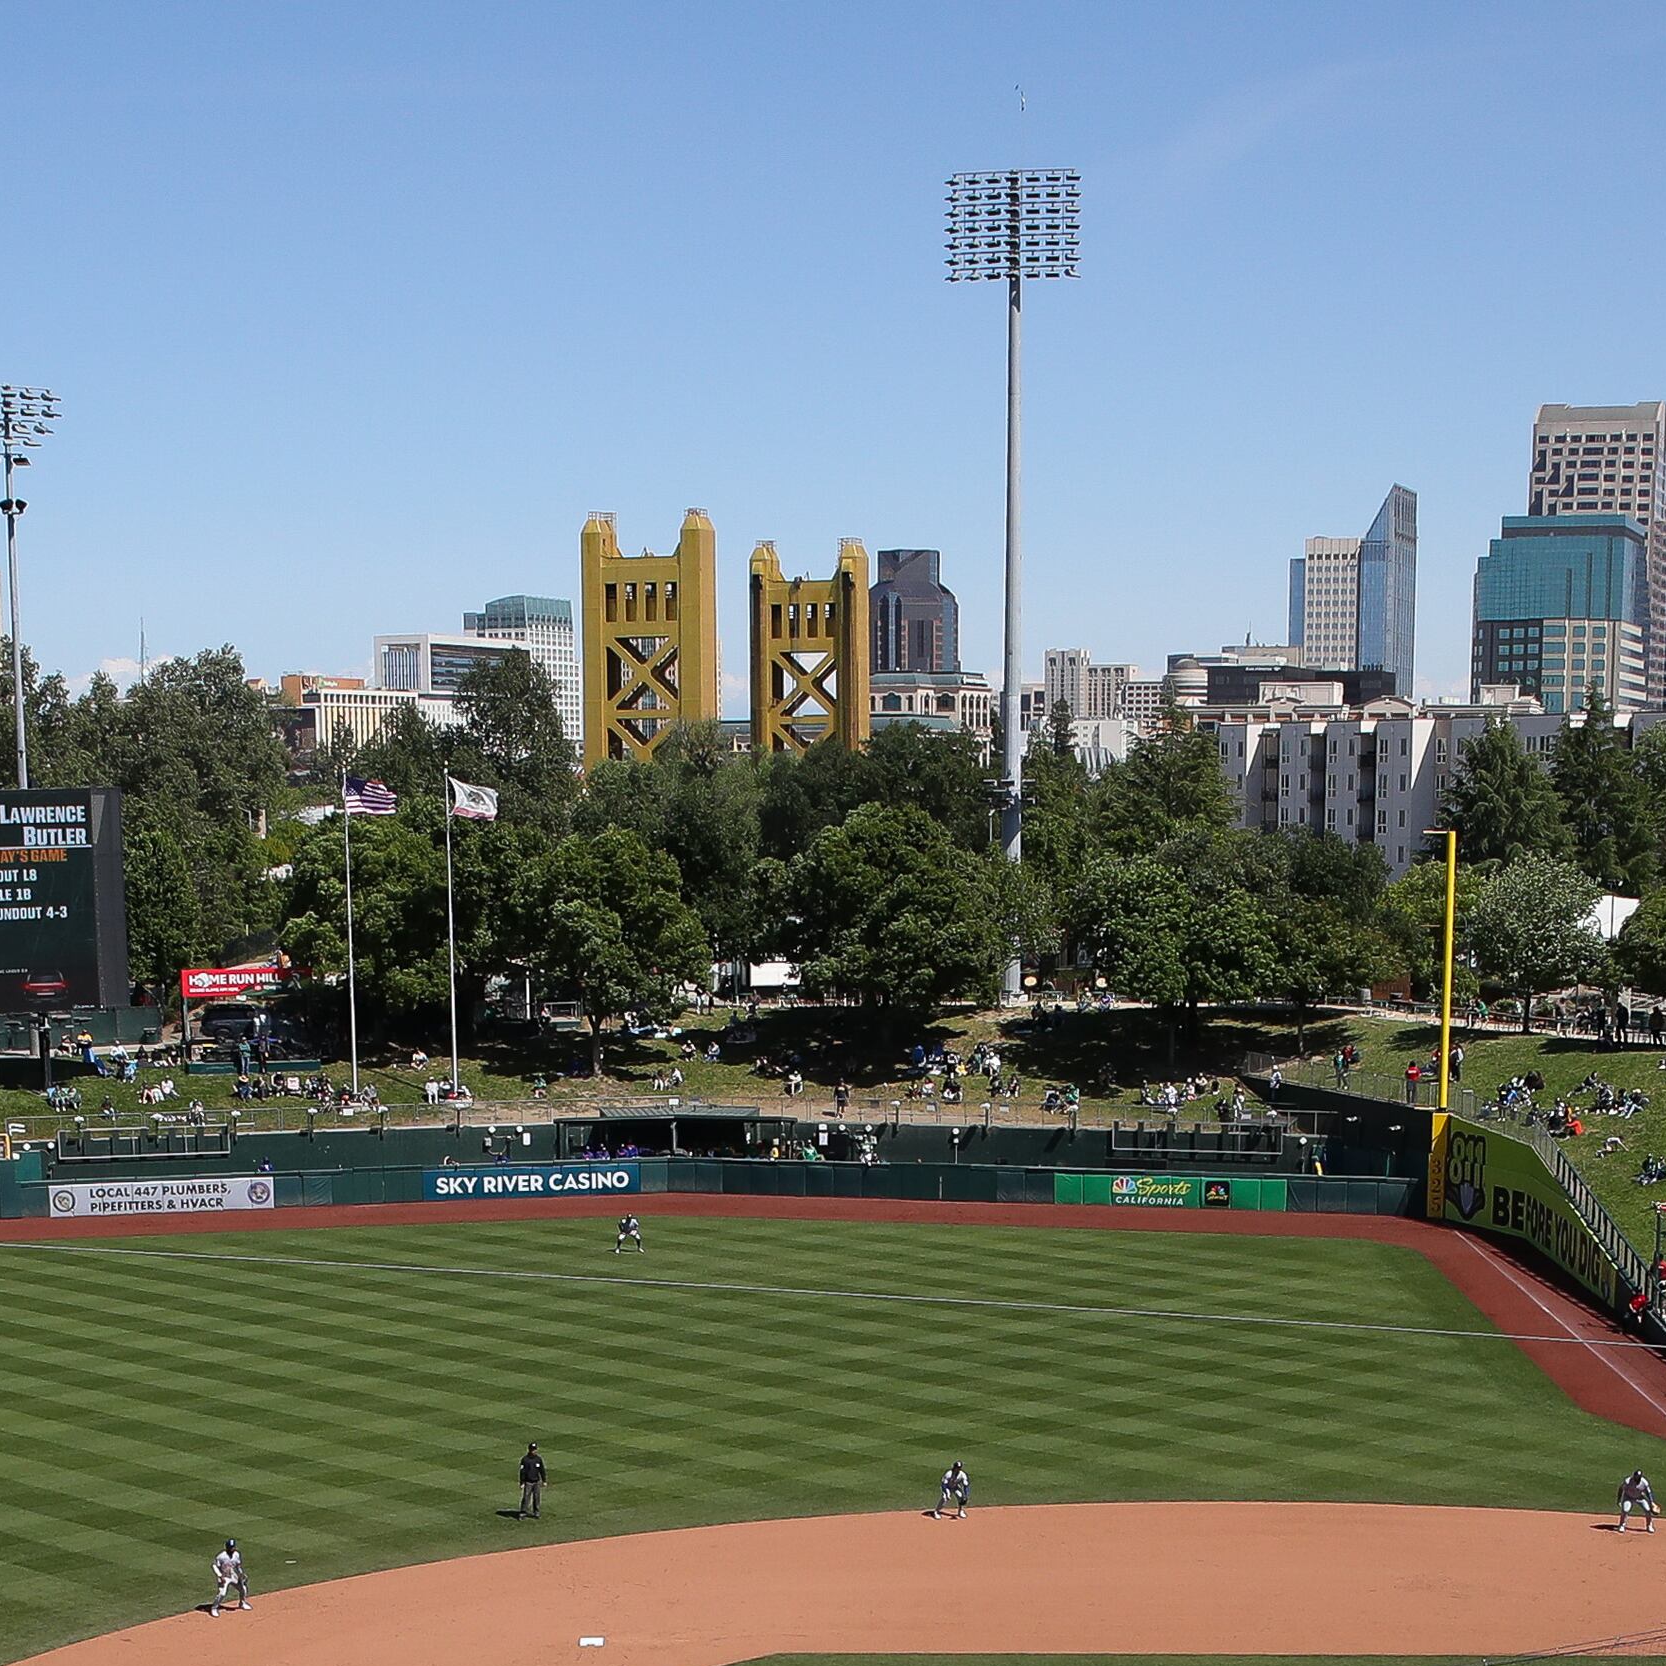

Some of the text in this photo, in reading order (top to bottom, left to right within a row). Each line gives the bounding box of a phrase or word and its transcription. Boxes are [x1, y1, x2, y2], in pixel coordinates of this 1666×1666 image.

[31, 849, 68, 863] GAME
[23, 869, 37, 882] L8
[16, 888, 32, 901] 1B
[46, 906, 68, 919] 4-3
[229, 973, 254, 984] RUN
[256, 972, 282, 983] HILL
[1451, 1131, 1486, 1190] 811
[435, 1169, 629, 1195] SKY RIVER CASINO
[1136, 1178, 1192, 1197] Sports
[1431, 1158, 1442, 1213] 325
[89, 1183, 231, 1199] LOCAL 447 PLUMBERS,
[90, 1198, 224, 1212] PIPEFITTERS & HVACR
[1115, 1195, 1184, 1206] CALIFORNIA
[1492, 1185, 1603, 1291] BEFORE YOU DIG
